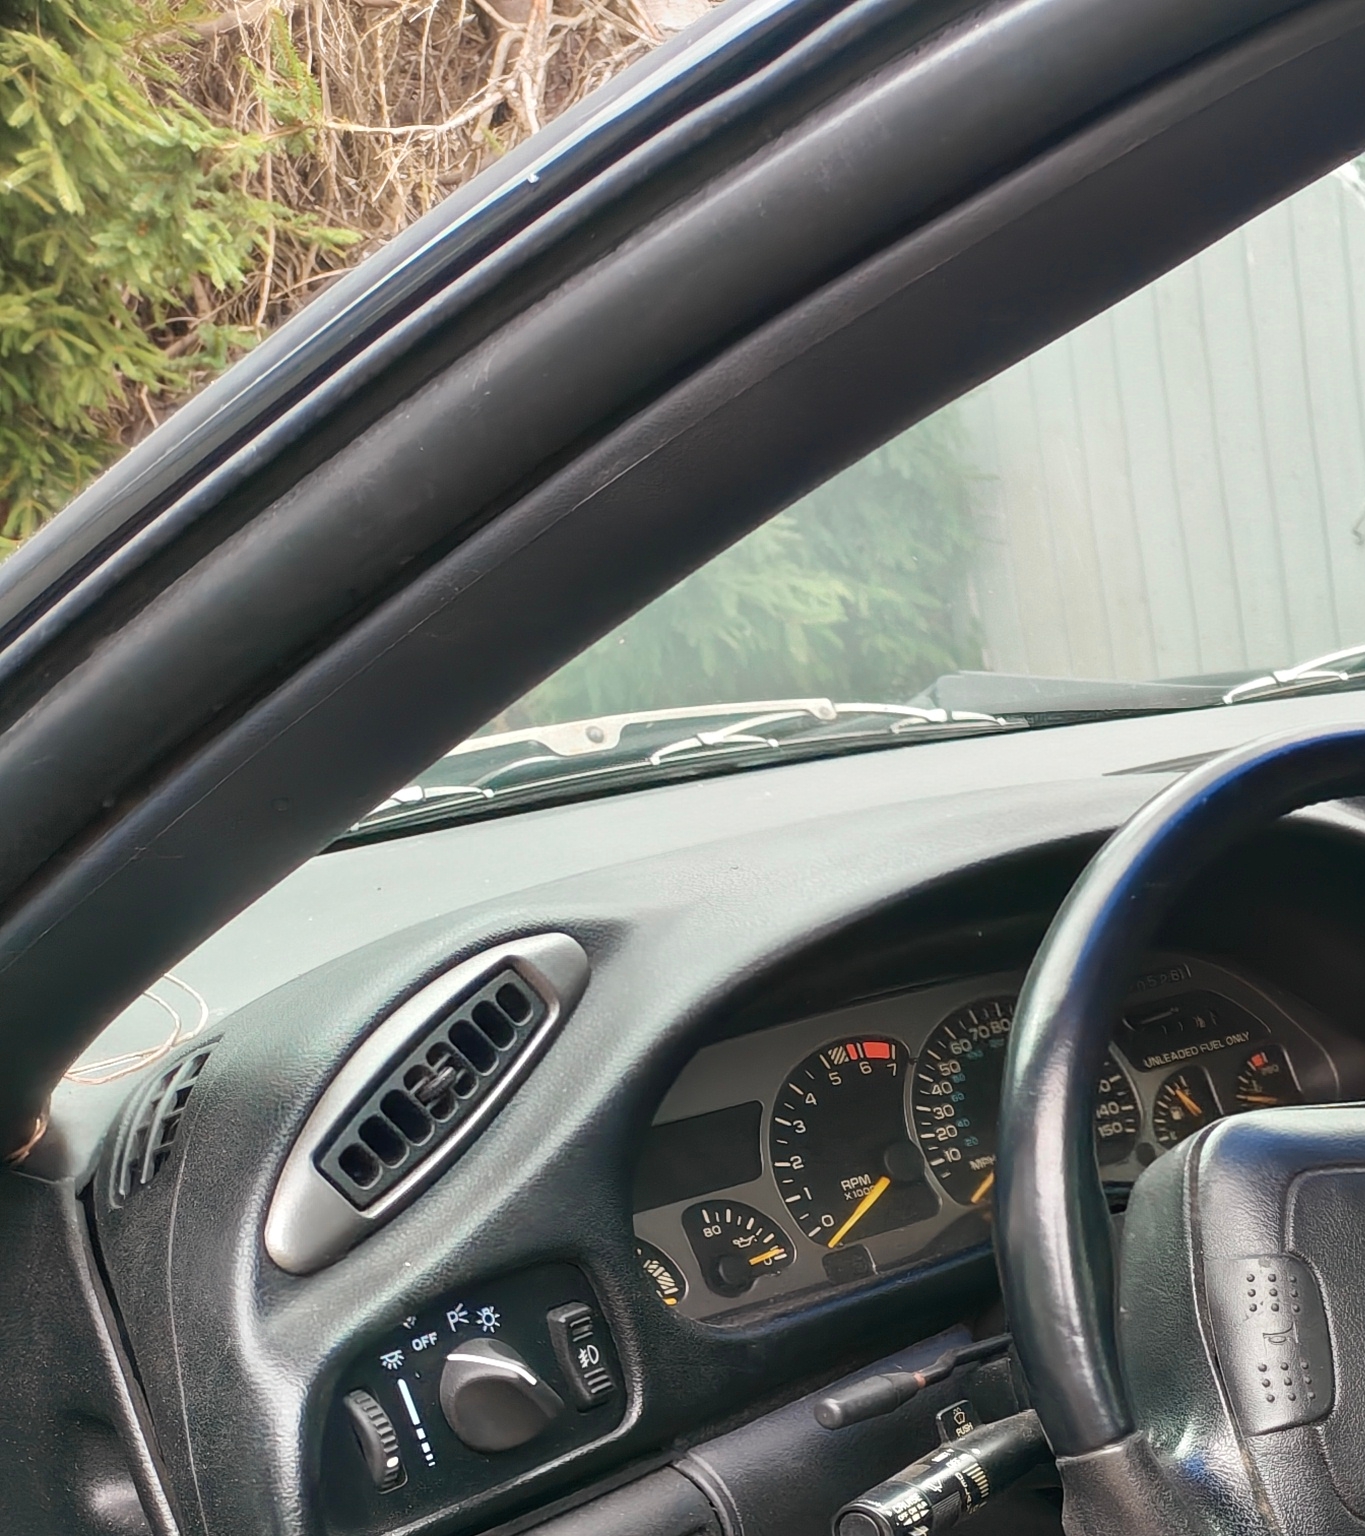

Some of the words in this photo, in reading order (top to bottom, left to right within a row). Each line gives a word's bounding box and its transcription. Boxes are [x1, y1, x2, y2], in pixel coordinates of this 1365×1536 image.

[968, 1025, 990, 1041] 70
[990, 1018, 1011, 1034] 80
[951, 1038, 972, 1054] 60
[1144, 1045, 1200, 1068] UNLEADED
[1200, 1038, 1225, 1054] FUEL
[1225, 1031, 1251, 1046] ONLY
[859, 1061, 872, 1075] 6
[886, 1062, 897, 1077] 7
[939, 1061, 961, 1077] 50
[828, 1071, 842, 1086] 5
[931, 1081, 953, 1096] 40
[805, 1092, 818, 1106] 4
[933, 1104, 955, 1120] 30
[792, 1120, 806, 1134] 3
[935, 1125, 958, 1142] 20
[1097, 1121, 1124, 1139] 150
[944, 1147, 962, 1162] 10
[790, 1155, 805, 1170] 2
[840, 1173, 872, 1192] RPM
[803, 1186, 812, 1200] 1
[821, 1214, 835, 1228] 0
[702, 1225, 722, 1238] 80
[412, 1331, 438, 1351] OFF
[956, 1422, 973, 1436] PUSH
